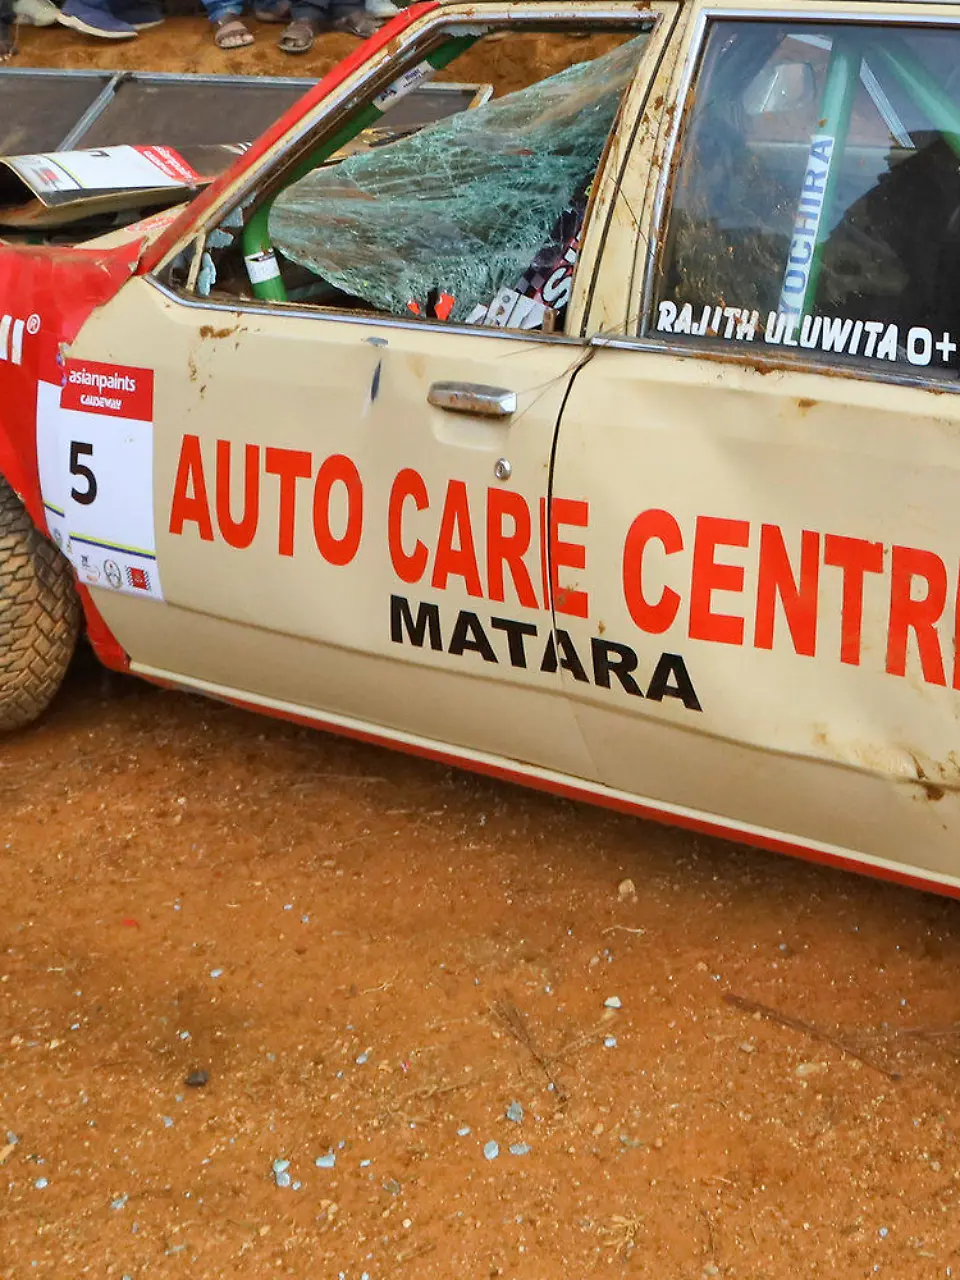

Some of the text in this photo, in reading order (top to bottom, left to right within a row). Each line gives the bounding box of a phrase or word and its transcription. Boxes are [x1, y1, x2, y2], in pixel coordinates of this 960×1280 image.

[657, 301, 760, 341] RAJITH
[765, 312, 899, 361] ULUWITA
[69, 368, 136, 394] asianpaints
[69, 440, 97, 505] 5
[169, 434, 363, 566] AUTO
[388, 468, 589, 618] CARE
[390, 594, 703, 712] MATARA
